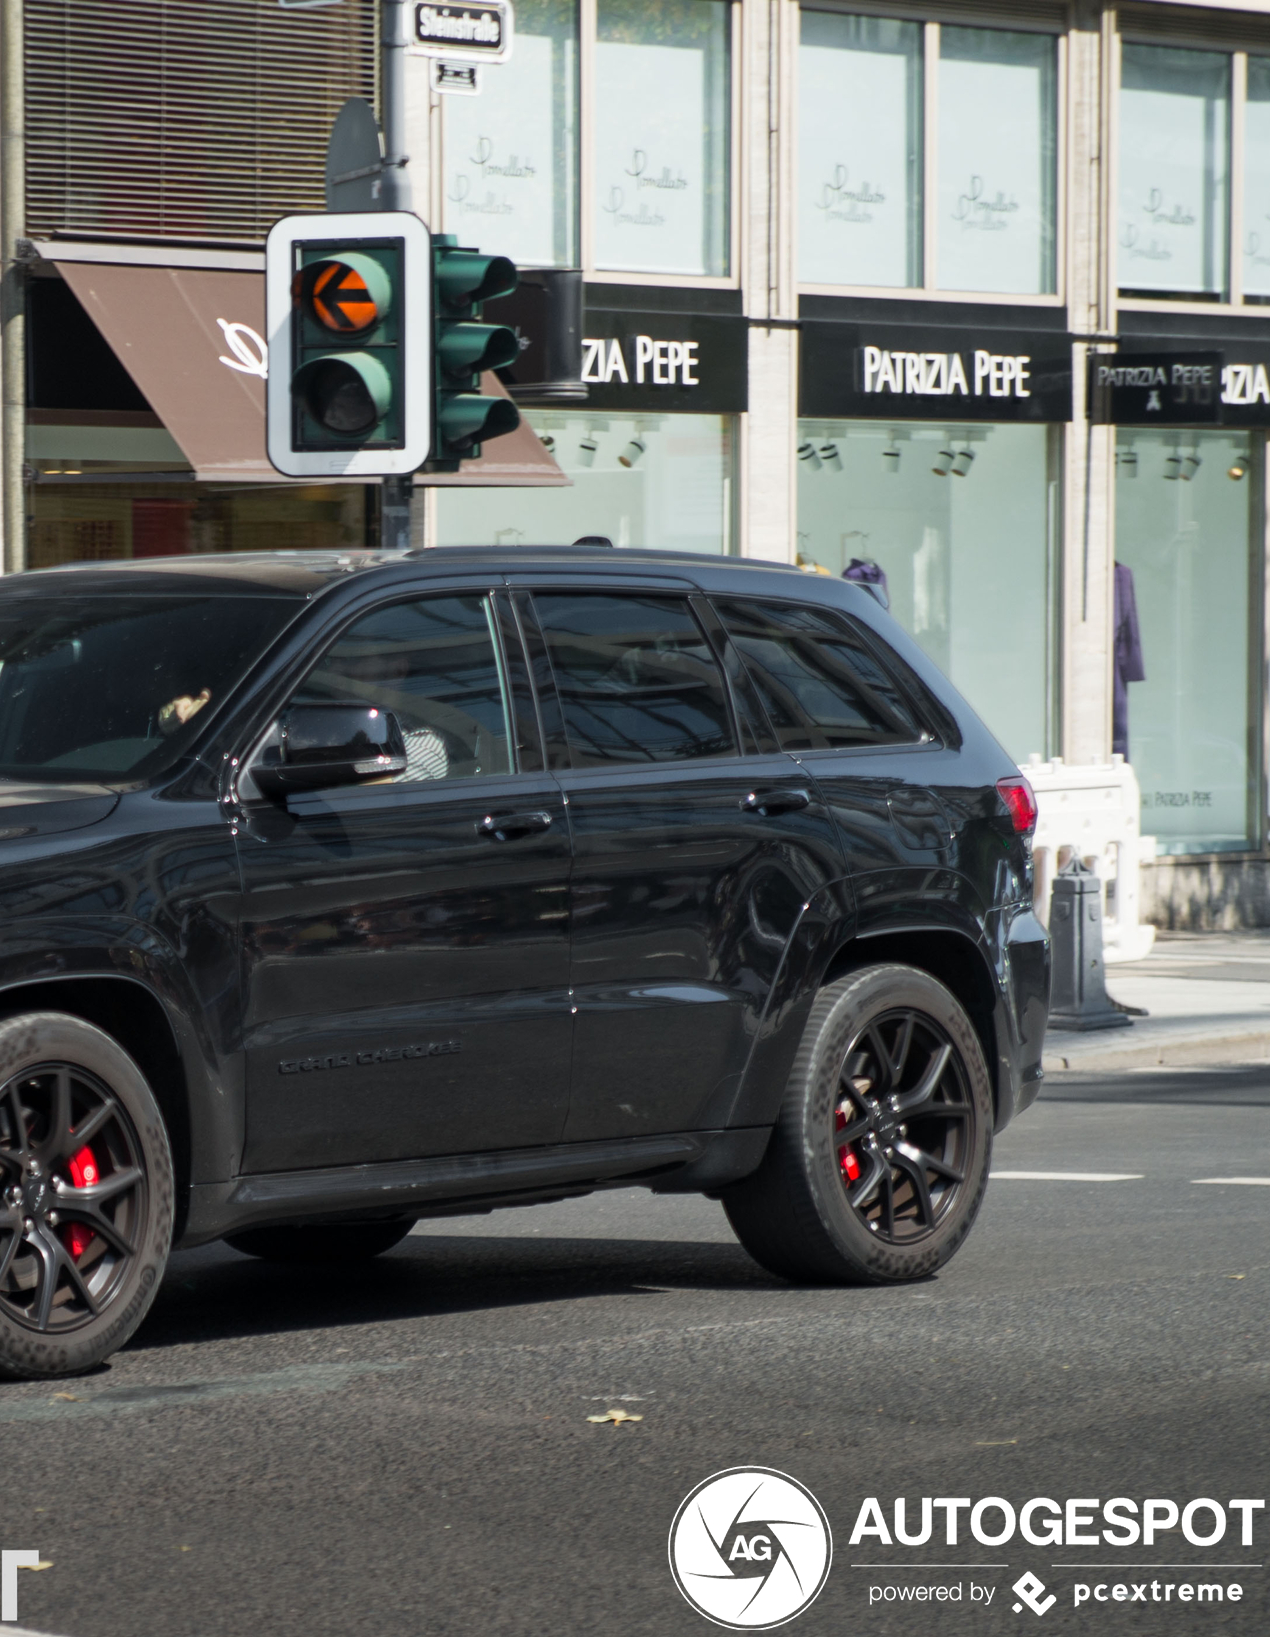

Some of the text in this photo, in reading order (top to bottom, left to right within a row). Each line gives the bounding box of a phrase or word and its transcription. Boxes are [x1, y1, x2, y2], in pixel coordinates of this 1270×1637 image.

[636, 335, 699, 385] PEPE
[864, 346, 1030, 397] PATRIZIA PEPE
[1098, 363, 1212, 386] PATRIZIA PEPE
[279, 1040, 462, 1074] GRAND CHEROKEE
